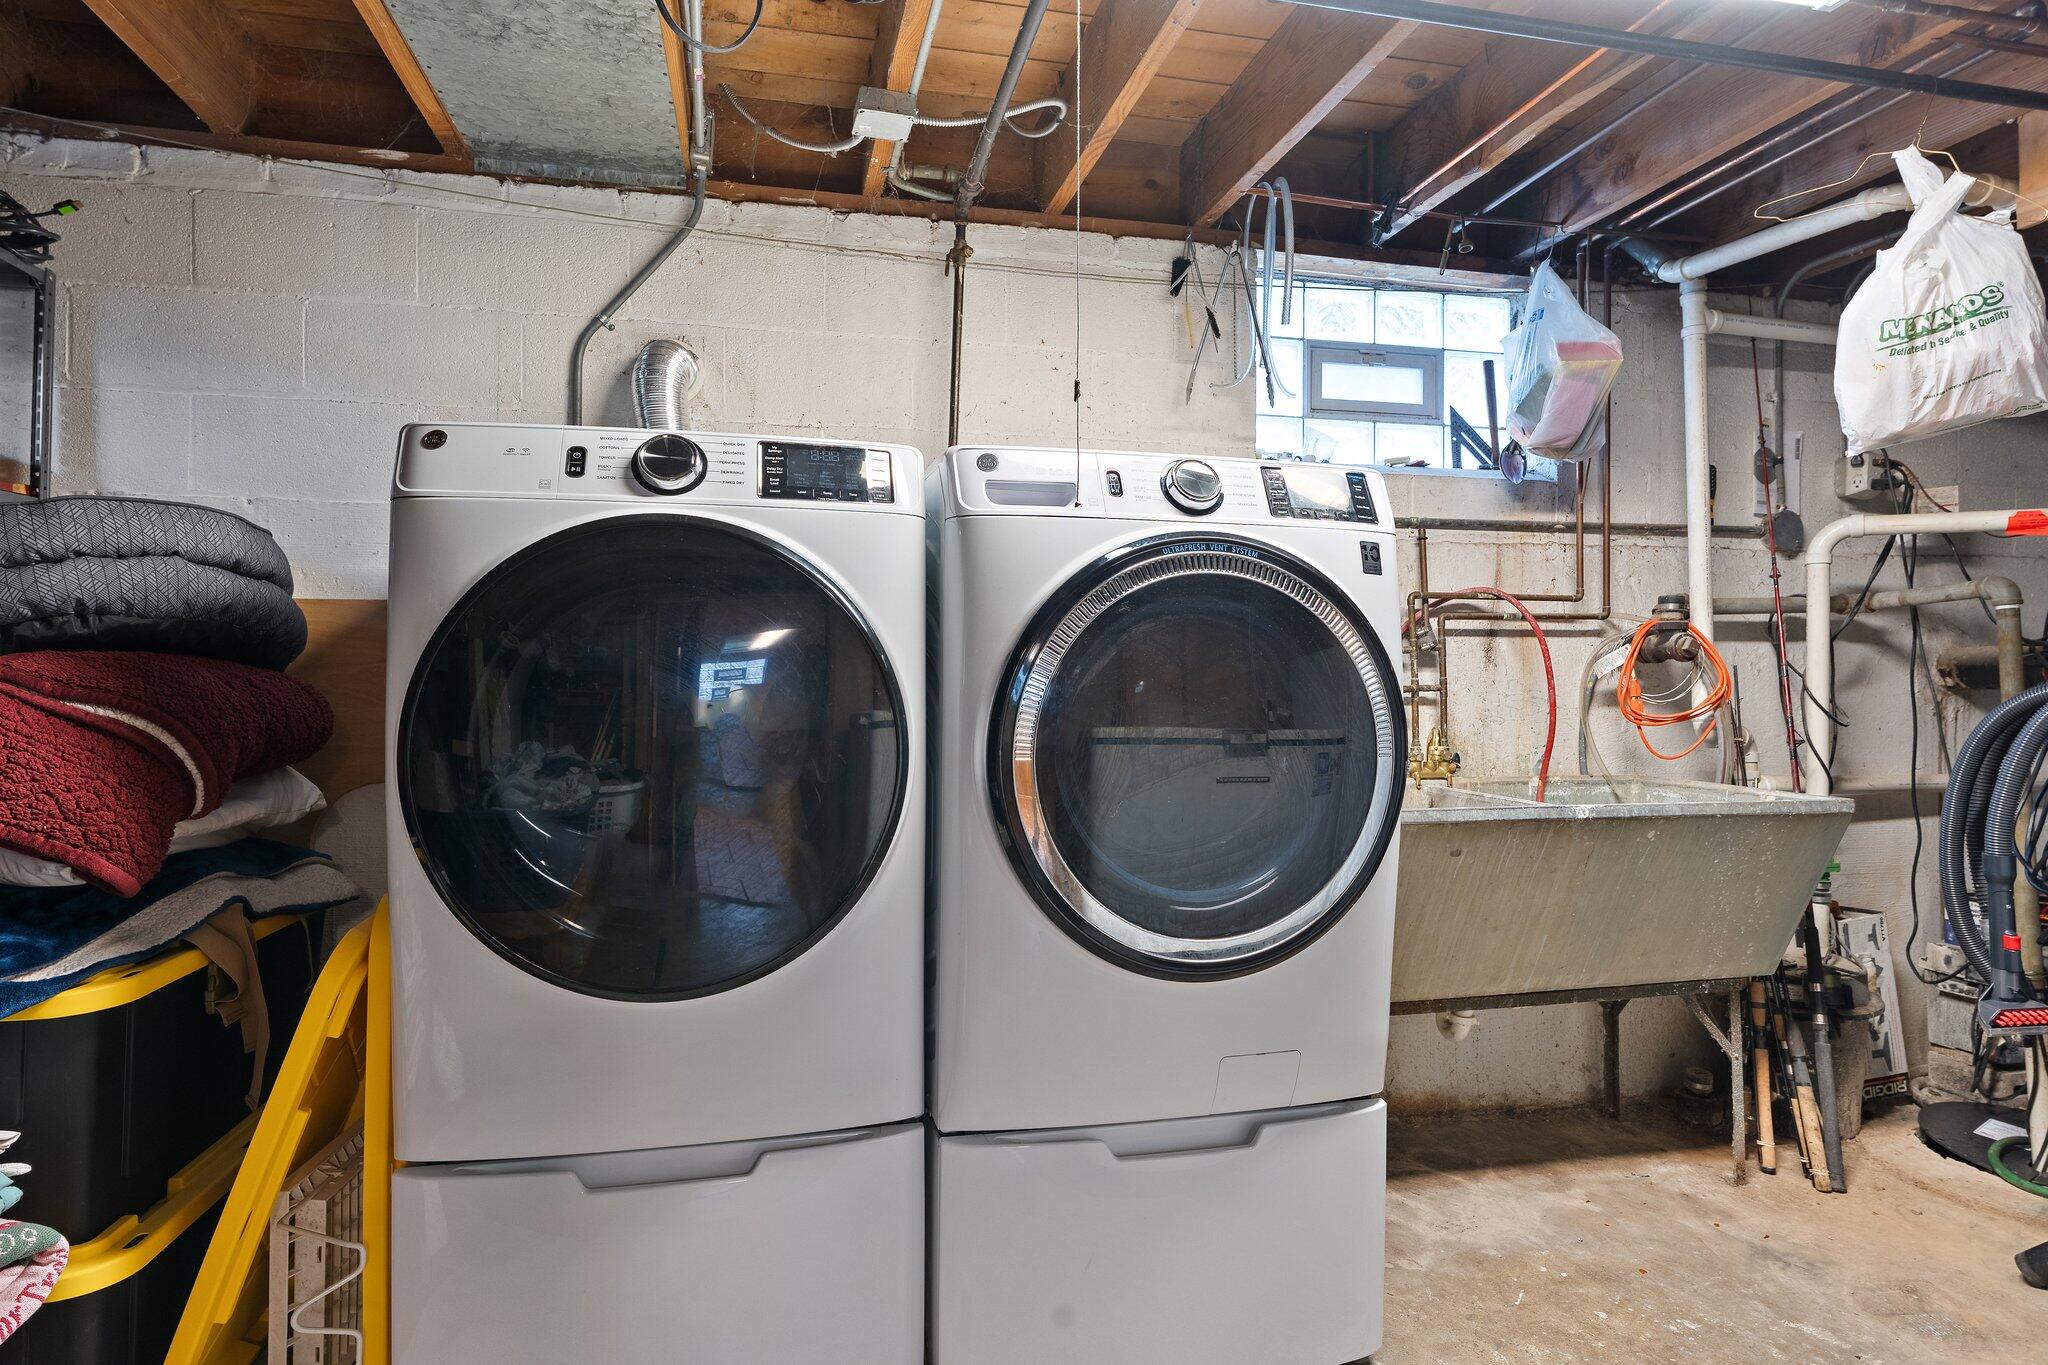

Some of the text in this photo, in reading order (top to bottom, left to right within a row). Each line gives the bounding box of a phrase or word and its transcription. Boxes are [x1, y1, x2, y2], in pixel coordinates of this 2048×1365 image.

[1969, 322, 1977, 331] &
[1978, 310, 2010, 327] Quality
[1162, 544, 1259, 558] ULTRAFRESH VENT SYSTEM
[1862, 1080, 1908, 1099] RIDGID
